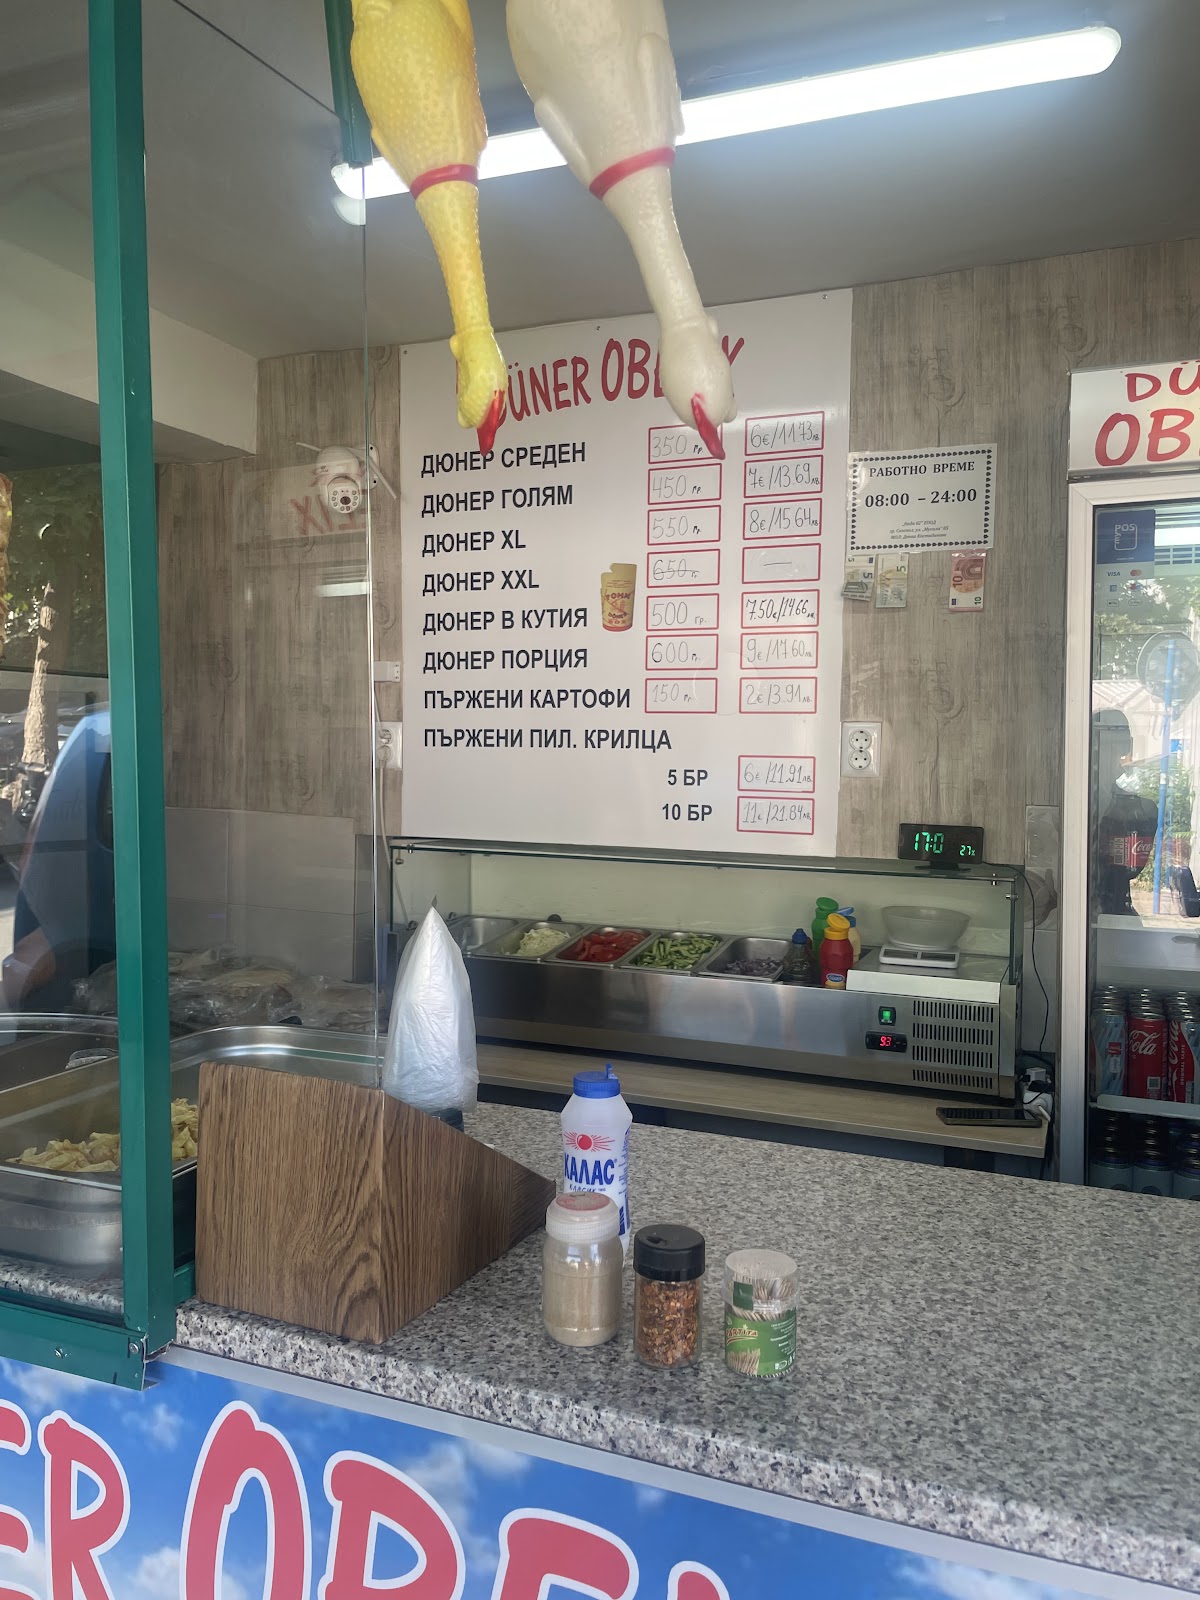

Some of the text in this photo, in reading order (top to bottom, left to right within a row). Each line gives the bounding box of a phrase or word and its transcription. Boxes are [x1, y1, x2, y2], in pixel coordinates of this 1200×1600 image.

[456, 354, 592, 429] ÜNER
[652, 434, 687, 458] 350
[421, 442, 585, 478] ДЮНЕР СРЕДЕН
[869, 461, 975, 477] РАБОТНО ВРЕМЕ
[652, 475, 687, 499] 450
[865, 493, 910, 508] 08:00
[930, 488, 977, 504] 24:00
[421, 485, 573, 518] ДЮНЕР ГОЛЯМ
[652, 516, 688, 539] 550
[422, 530, 526, 557] ДЮНЕР XL
[422, 569, 540, 597] ДЮНЕР XXL
[422, 608, 588, 635] ДЮНЕР В КУТИЯ
[652, 602, 688, 626] 500
[422, 648, 588, 674] ДЮНЕР ПОРЦИЯ
[652, 641, 689, 663] 600
[424, 688, 631, 709] ПЪРЖЕНИ КАРТОФИ
[652, 683, 680, 702] 150
[424, 729, 672, 753] ПЪРЖЕНИ ПИЛ. КРИЛЦА
[667, 769, 708, 786] 5 БР
[662, 803, 713, 821] 10 БР
